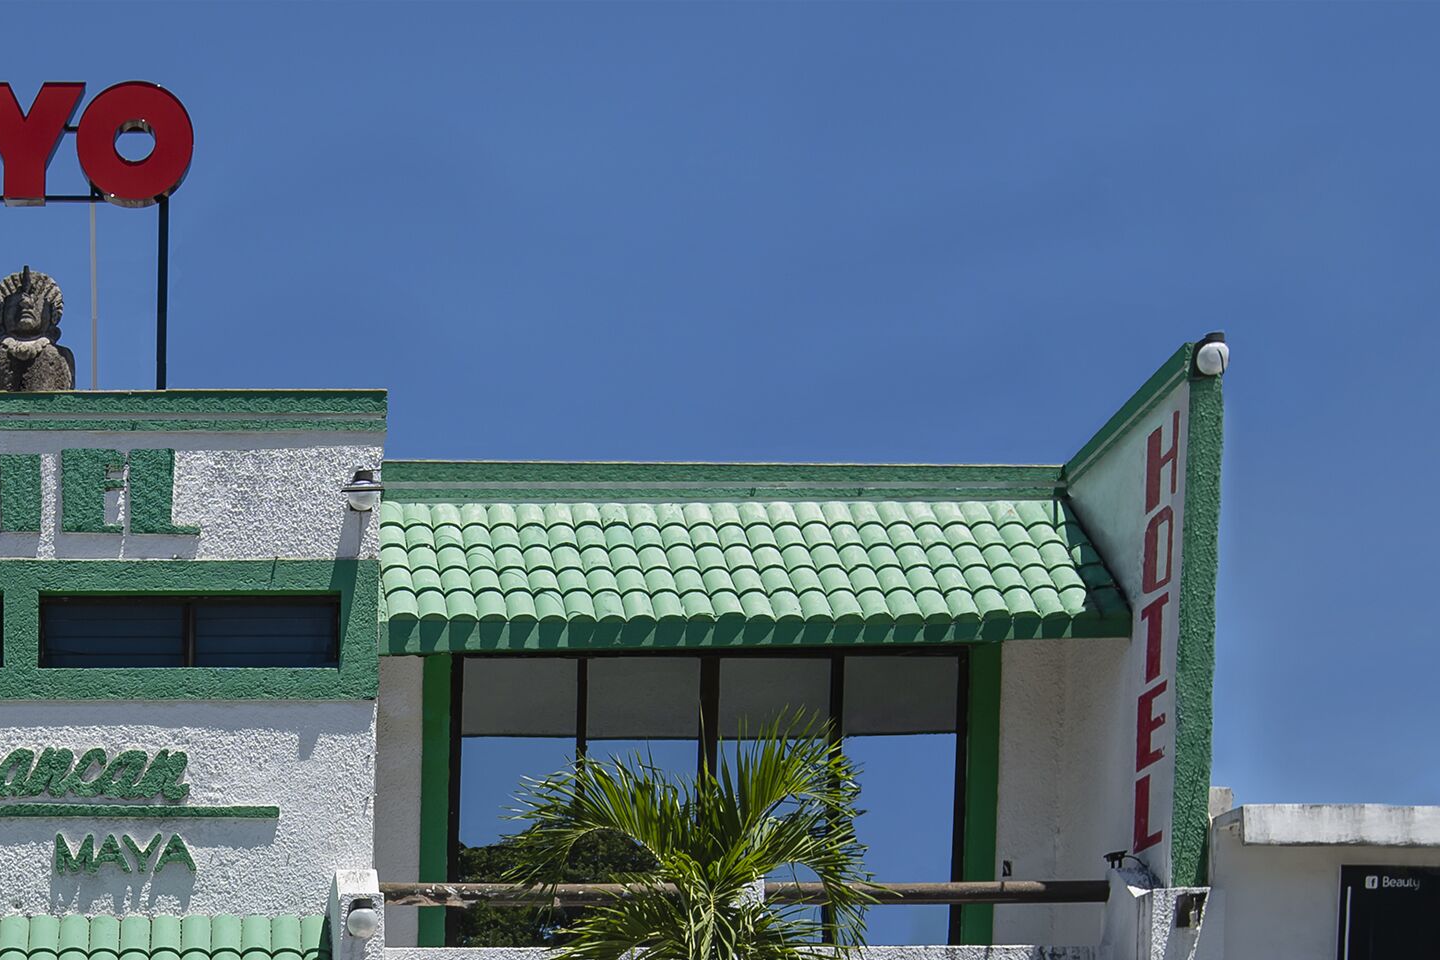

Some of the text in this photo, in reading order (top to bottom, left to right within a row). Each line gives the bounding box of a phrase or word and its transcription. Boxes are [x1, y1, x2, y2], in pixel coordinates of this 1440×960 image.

[1133, 411, 1180, 853] HOTEL
[54, 832, 197, 874] MAYA
[1382, 876, 1420, 890] Beauty
